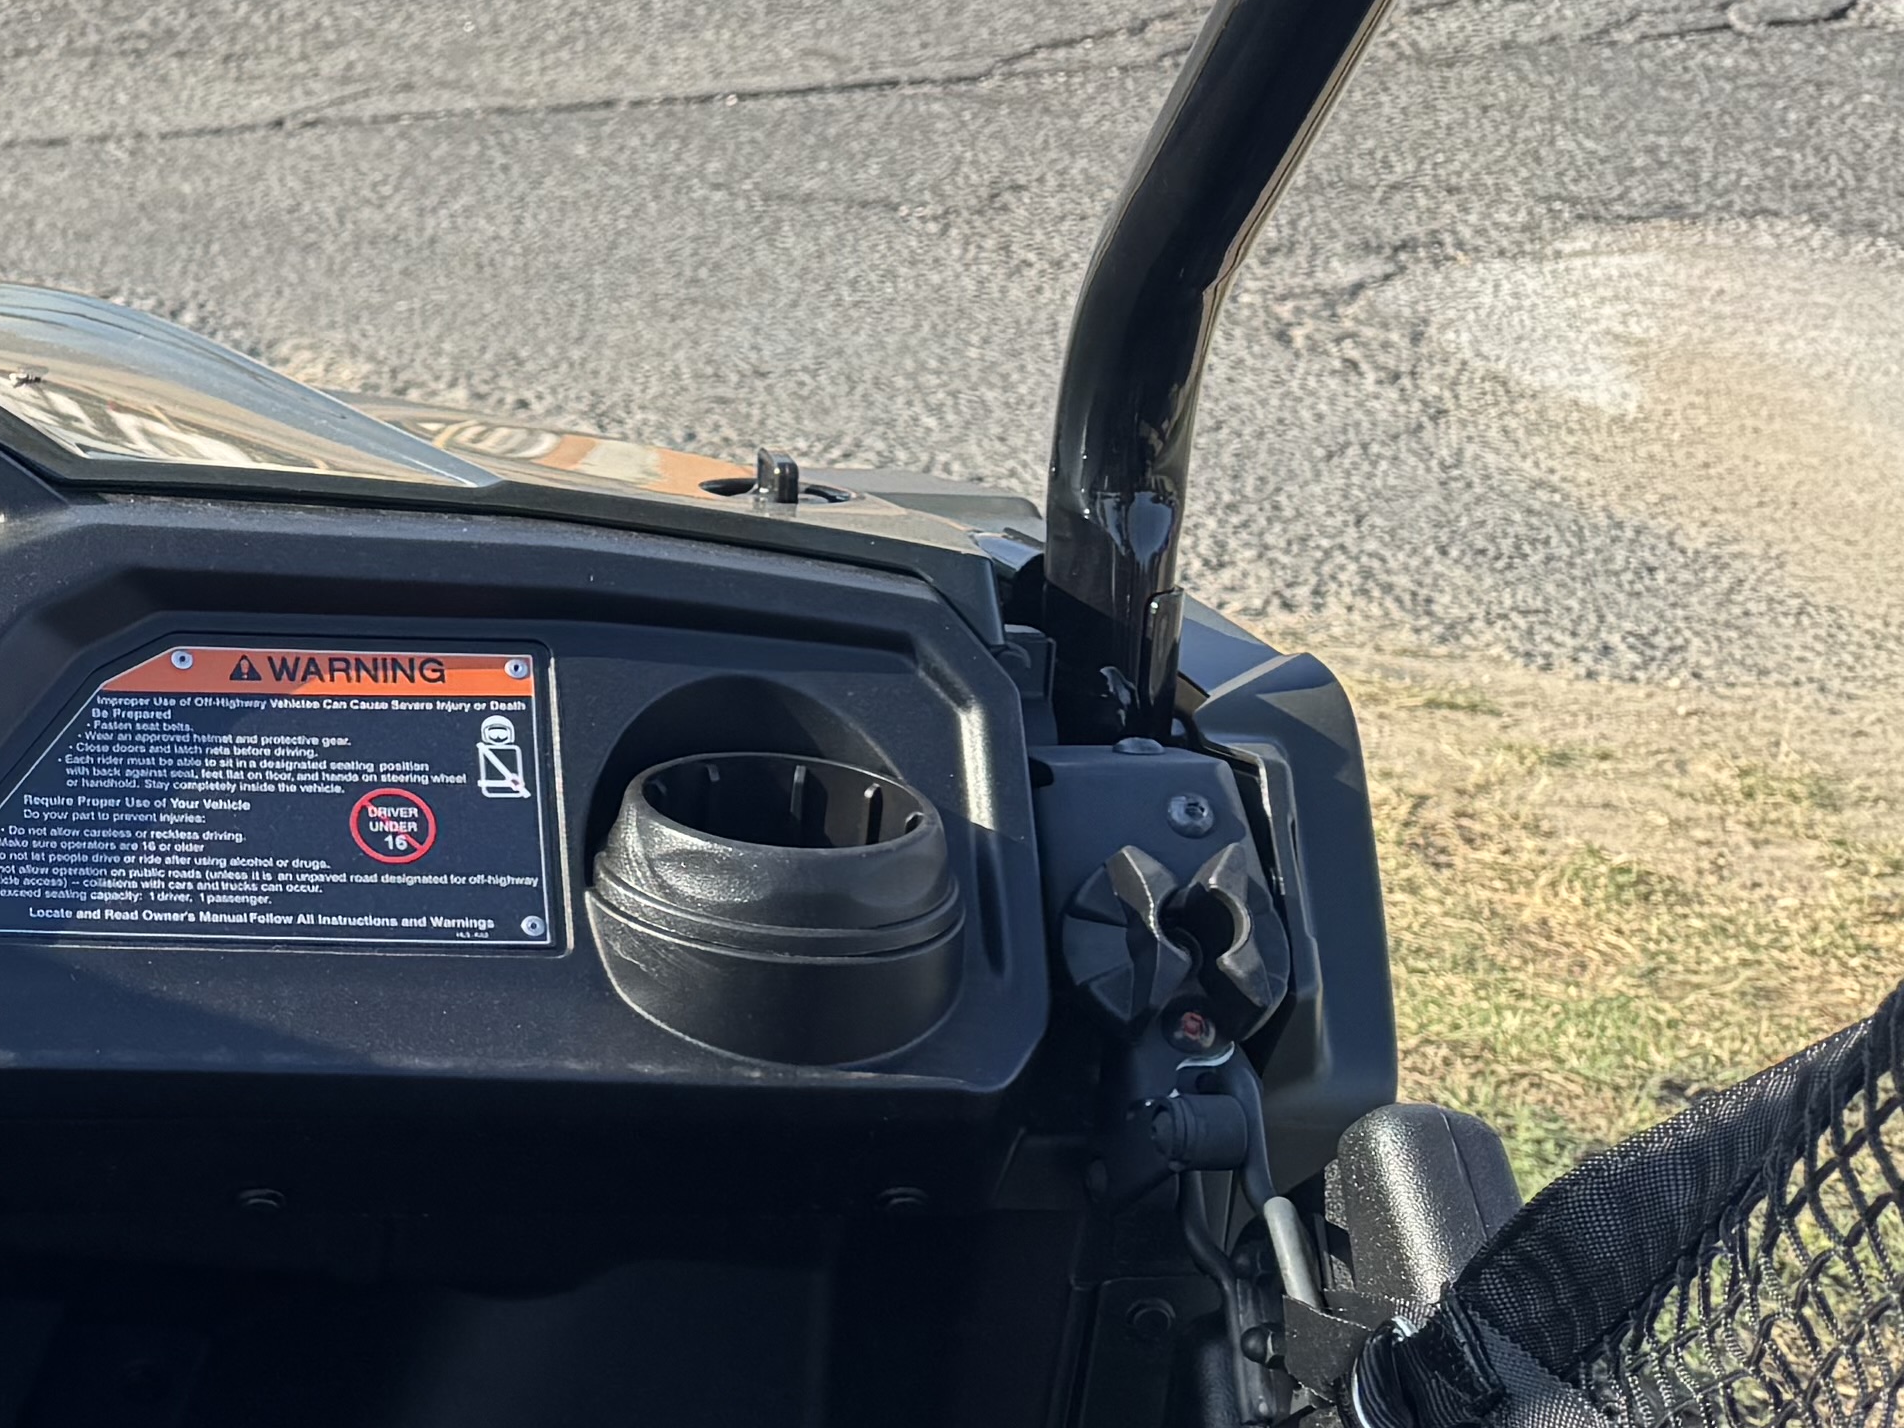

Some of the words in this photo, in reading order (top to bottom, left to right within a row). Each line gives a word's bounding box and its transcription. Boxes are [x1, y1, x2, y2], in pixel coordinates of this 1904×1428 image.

[267, 656, 446, 684] WARNING
[97, 696, 150, 707] Improper
[153, 697, 176, 706] Use
[180, 697, 191, 707] of
[270, 699, 320, 709] Vehicles
[323, 699, 347, 709] Can
[350, 700, 388, 709] Cause
[391, 701, 433, 710] Severe
[437, 701, 470, 712] Injury
[490, 701, 526, 711] Death
[92, 709, 108, 718] Be
[113, 709, 172, 721] Prepared
[94, 721, 132, 730] Fasten
[135, 722, 160, 731] seat
[85, 732, 114, 741] Wear
[141, 733, 190, 745] approved
[193, 734, 232, 743] helmet
[236, 734, 257, 744] and
[261, 735, 319, 746] protective
[322, 737, 351, 747] gear.
[76, 743, 109, 752] Close
[113, 744, 145, 753] doors
[149, 744, 171, 753] and
[205, 746, 229, 754] nets
[233, 746, 270, 756] before
[274, 747, 318, 758] driving.
[65, 755, 93, 764] Each
[97, 756, 124, 765] rider
[127, 757, 155, 766] must
[159, 756, 174, 766] be
[205, 758, 216, 767] to
[219, 759, 233, 768] sit
[236, 758, 246, 768] in
[259, 759, 327, 771] designated
[330, 761, 374, 772] seating
[379, 762, 429, 773] position
[66, 766, 90, 775] with
[93, 766, 120, 776] back
[201, 768, 223, 779] feet
[226, 769, 244, 779] flat
[247, 771, 263, 780] on
[297, 772, 318, 781] and
[322, 772, 359, 782] hands
[362, 774, 378, 782] on
[381, 773, 428, 785] steering
[431, 774, 467, 783] wheel
[67, 779, 78, 787] or
[82, 779, 139, 788] handhold.
[144, 780, 169, 790] Stay
[173, 781, 236, 793] completely
[240, 782, 275, 792] inside
[278, 783, 296, 792] the
[300, 782, 345, 793] vehicle.
[24, 795, 73, 807] Require
[78, 796, 121, 809] Proper
[125, 798, 149, 808] Use
[154, 798, 167, 808] of
[170, 798, 199, 809] Your
[203, 799, 250, 810] Vehicle
[24, 809, 39, 819] Do
[43, 811, 68, 822] your
[72, 811, 95, 823] part
[98, 812, 109, 821] to
[113, 812, 156, 824] prevent
[367, 807, 419, 819] DRIVER
[9, 826, 25, 835] Do
[28, 827, 47, 836] not
[150, 829, 199, 840] reckless
[202, 832, 246, 843] driving.
[369, 821, 418, 833] UNDER
[32, 840, 57, 848] sure
[61, 841, 116, 852] operators
[142, 842, 155, 851] 16
[175, 842, 204, 852] older
[384, 834, 408, 850] 16
[10, 851, 28, 861] not
[31, 852, 45, 861] let
[48, 852, 88, 864] people
[92, 853, 120, 863] drive
[139, 854, 161, 864] ride
[165, 856, 191, 865] after
[194, 856, 226, 867] using
[230, 856, 273, 867] alcohol
[276, 859, 289, 867] or
[292, 858, 330, 870] drugs.
[129, 867, 165, 879] public
[168, 868, 201, 878] roads
[278, 873, 292, 881] an
[350, 873, 377, 883] road
[381, 874, 448, 886] designated
[450, 874, 466, 885] for
[469, 875, 538, 887] off-highway
[30, 908, 72, 918] Locate
[76, 909, 100, 919] and
[104, 909, 138, 920] Read
[143, 910, 195, 921] Owner's
[199, 911, 246, 923] Manual
[249, 912, 292, 924] Follow
[297, 914, 313, 924] All
[318, 914, 398, 927] Instructions
[402, 916, 426, 927] and
[430, 917, 494, 929] Warnings
